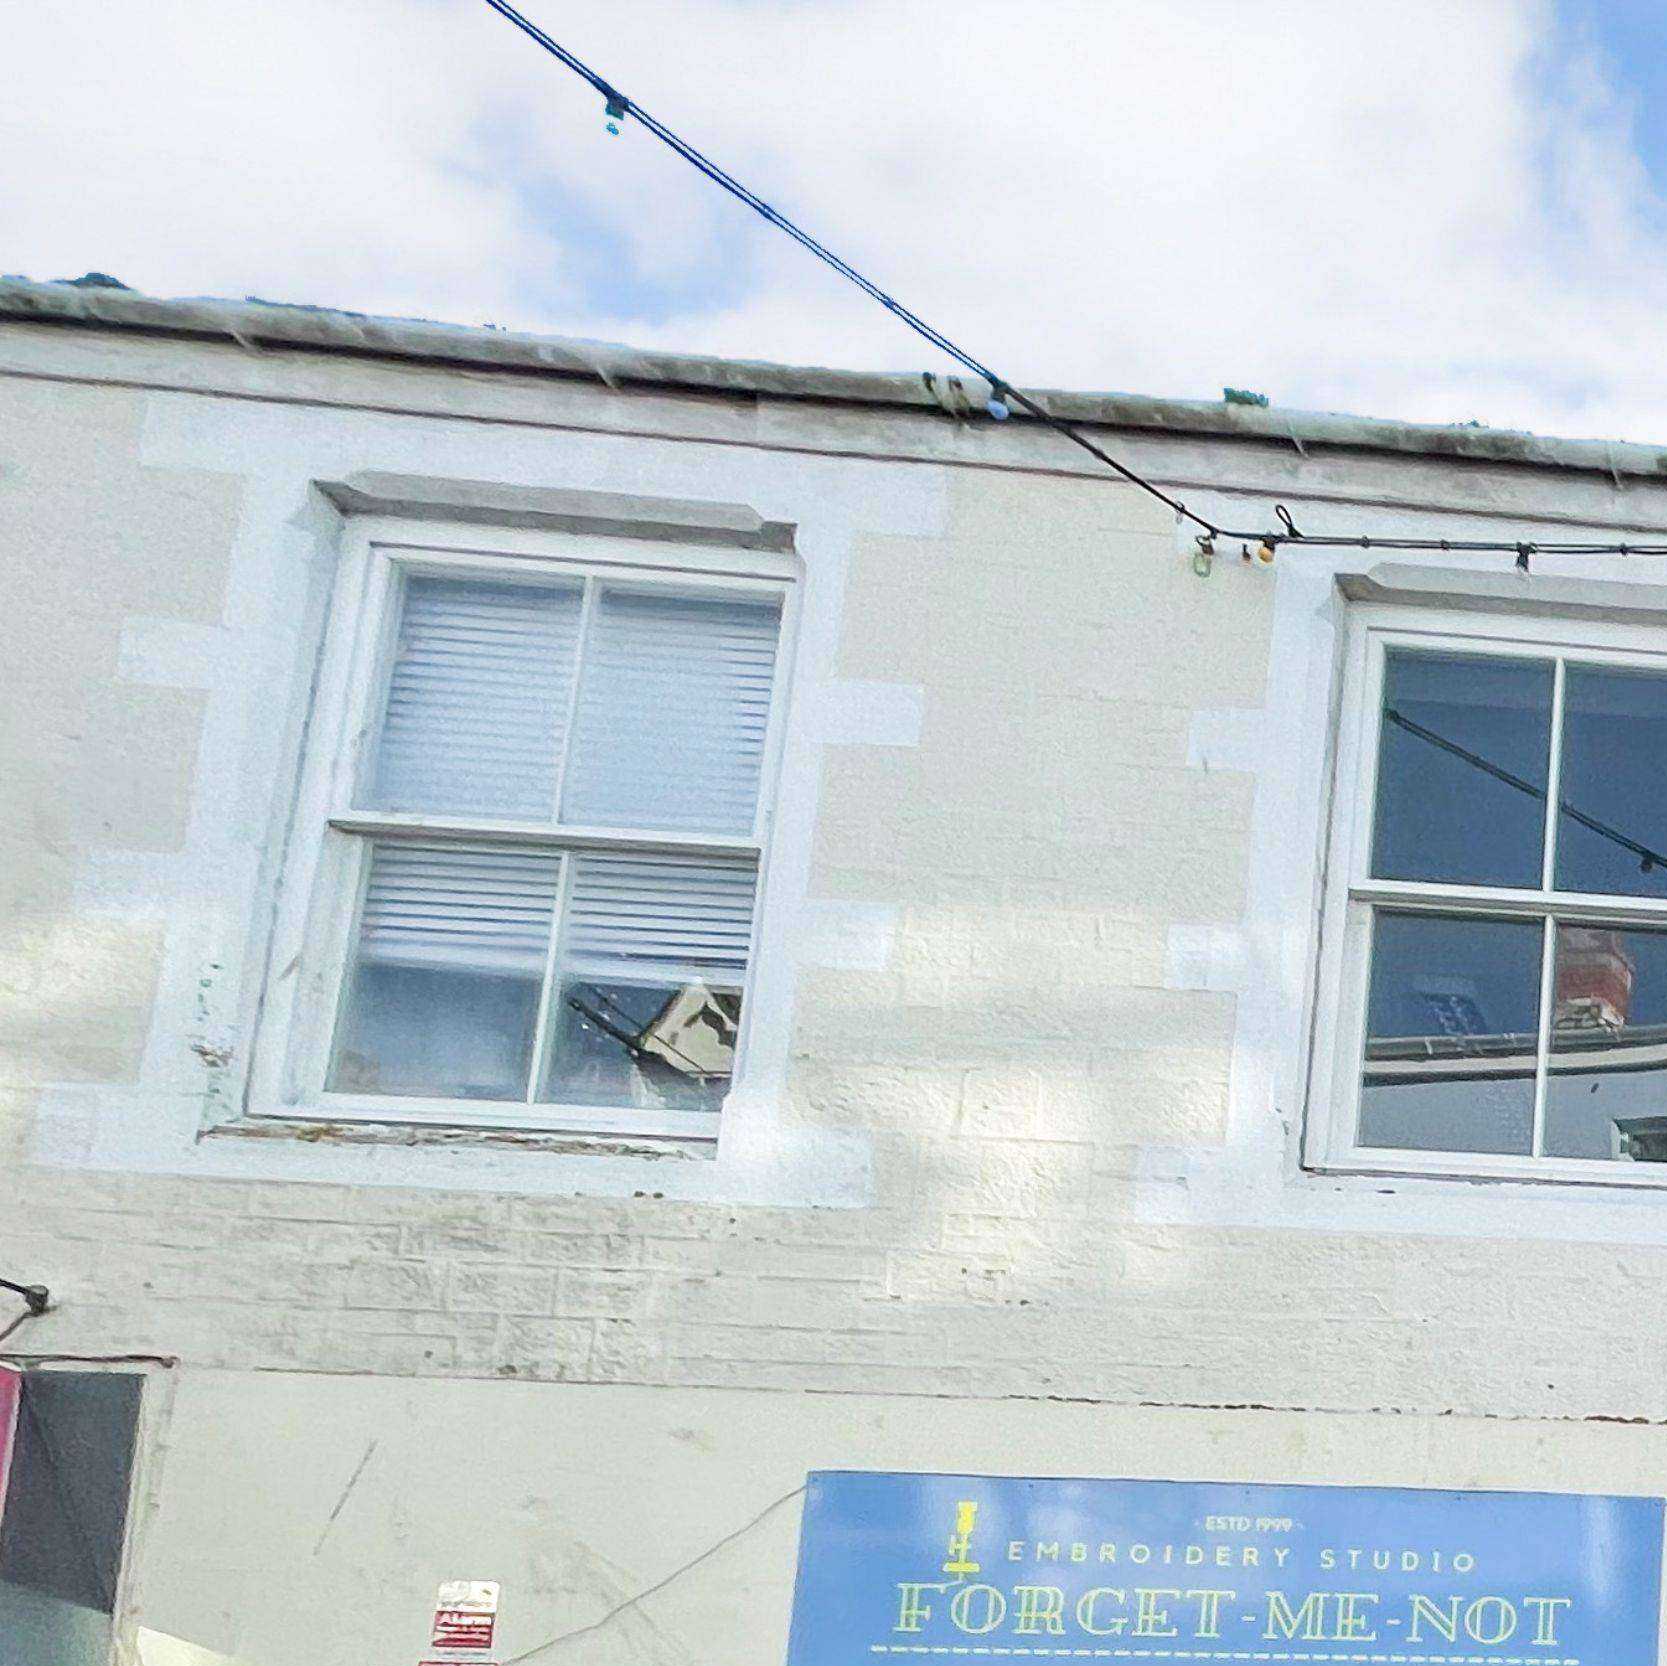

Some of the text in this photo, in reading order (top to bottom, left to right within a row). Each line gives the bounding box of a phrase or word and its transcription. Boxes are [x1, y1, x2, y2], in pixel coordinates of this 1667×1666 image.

[1204, 1515, 1293, 1534] ESTD 1999
[1008, 1540, 1477, 1574] EMBROIDERY STUDIO
[892, 1581, 1572, 1646] FORGET-ME-NOT
